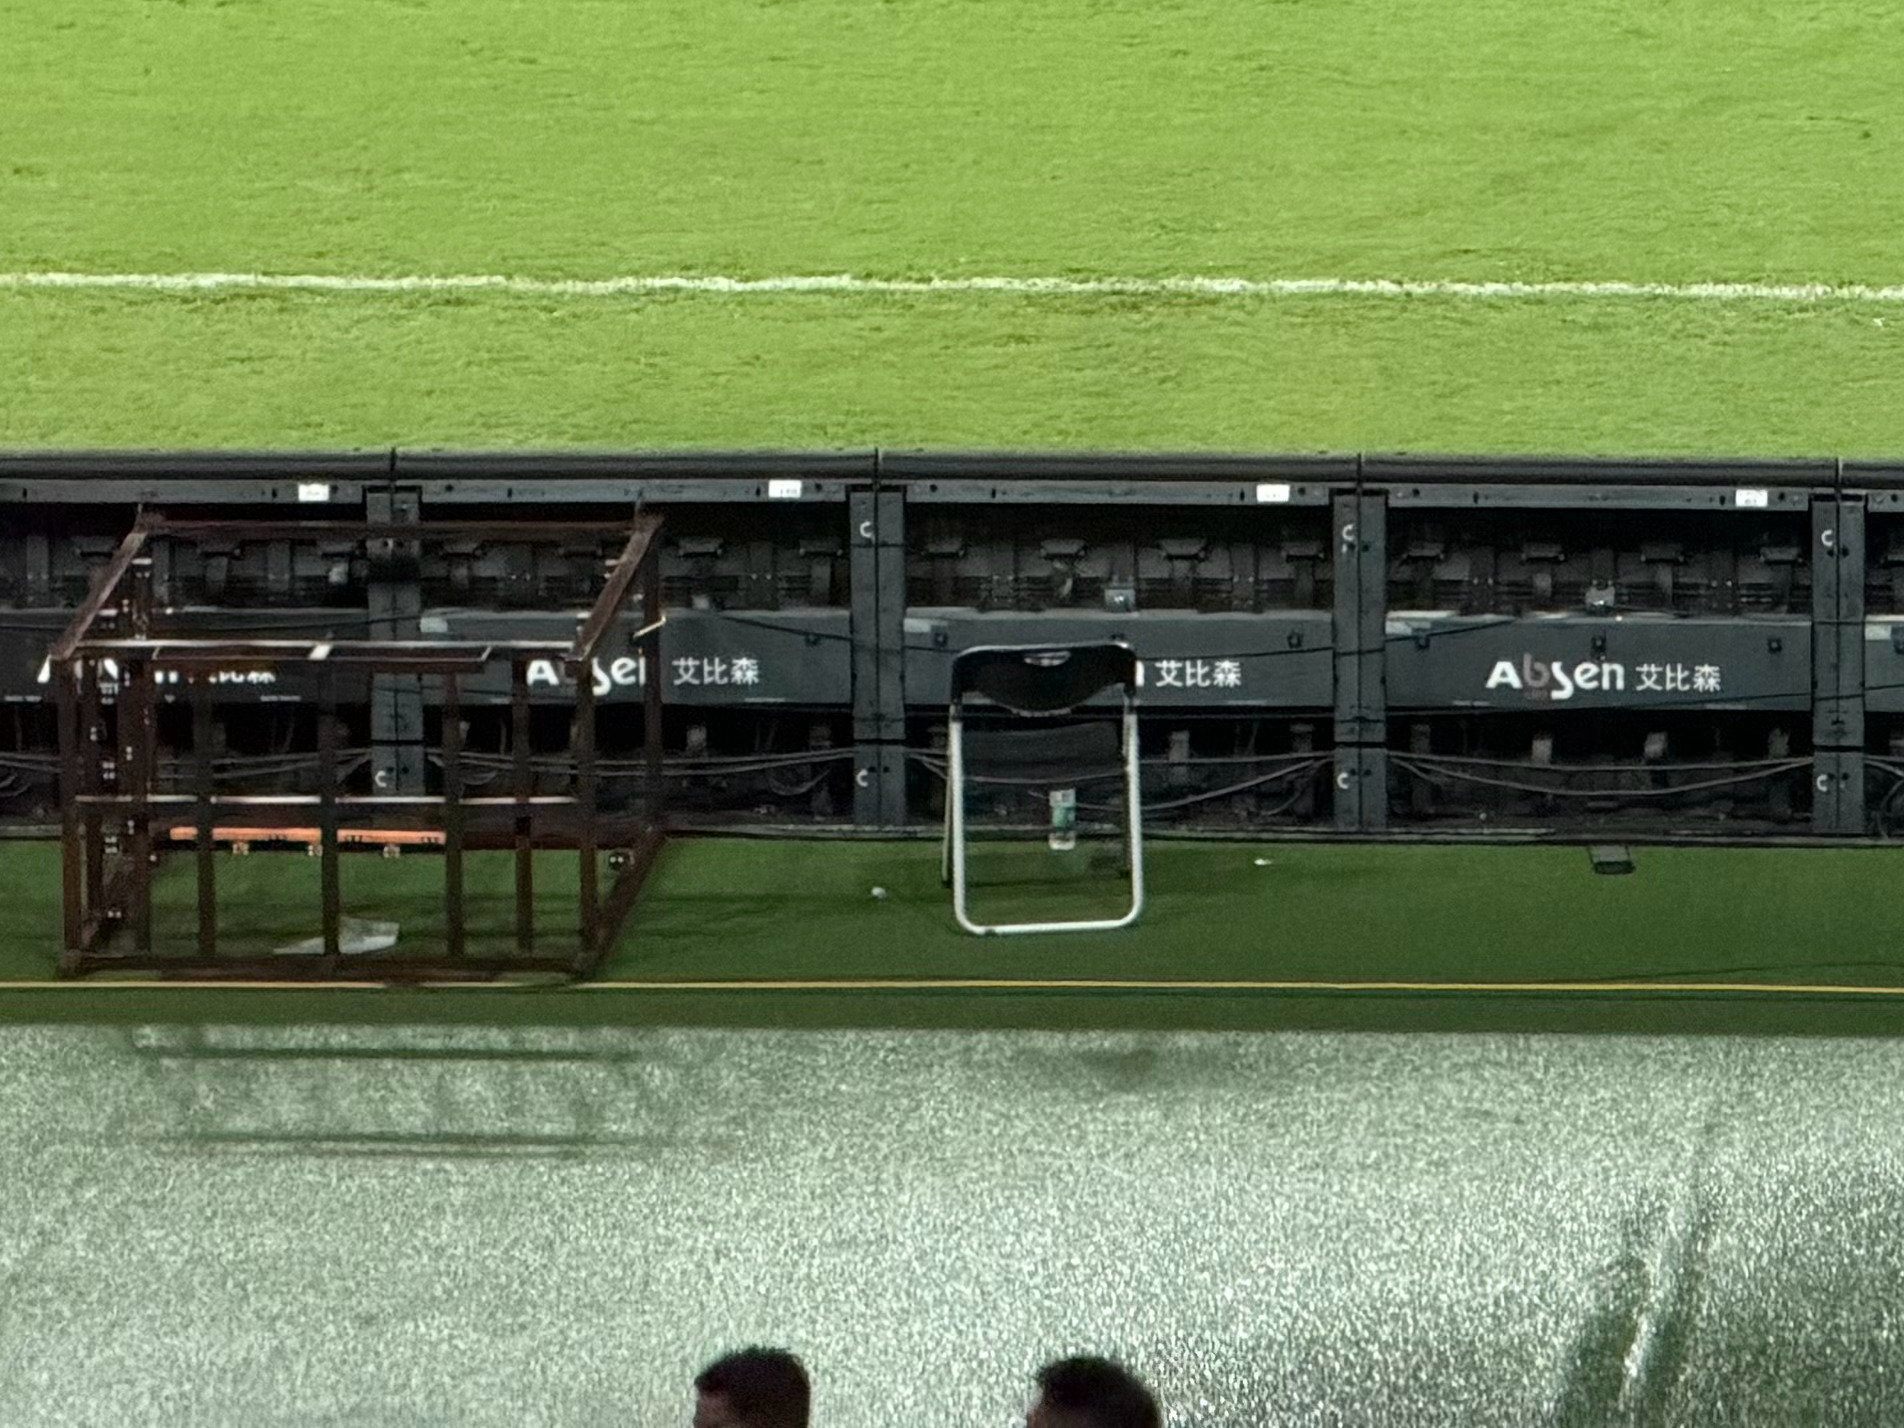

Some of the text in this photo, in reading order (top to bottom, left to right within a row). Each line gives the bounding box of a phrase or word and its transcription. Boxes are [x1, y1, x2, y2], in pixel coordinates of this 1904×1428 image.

[672, 657, 760, 686] 艾比森
[1155, 659, 1242, 687] 艾比森
[1485, 652, 1722, 700] Absen 艾比森
